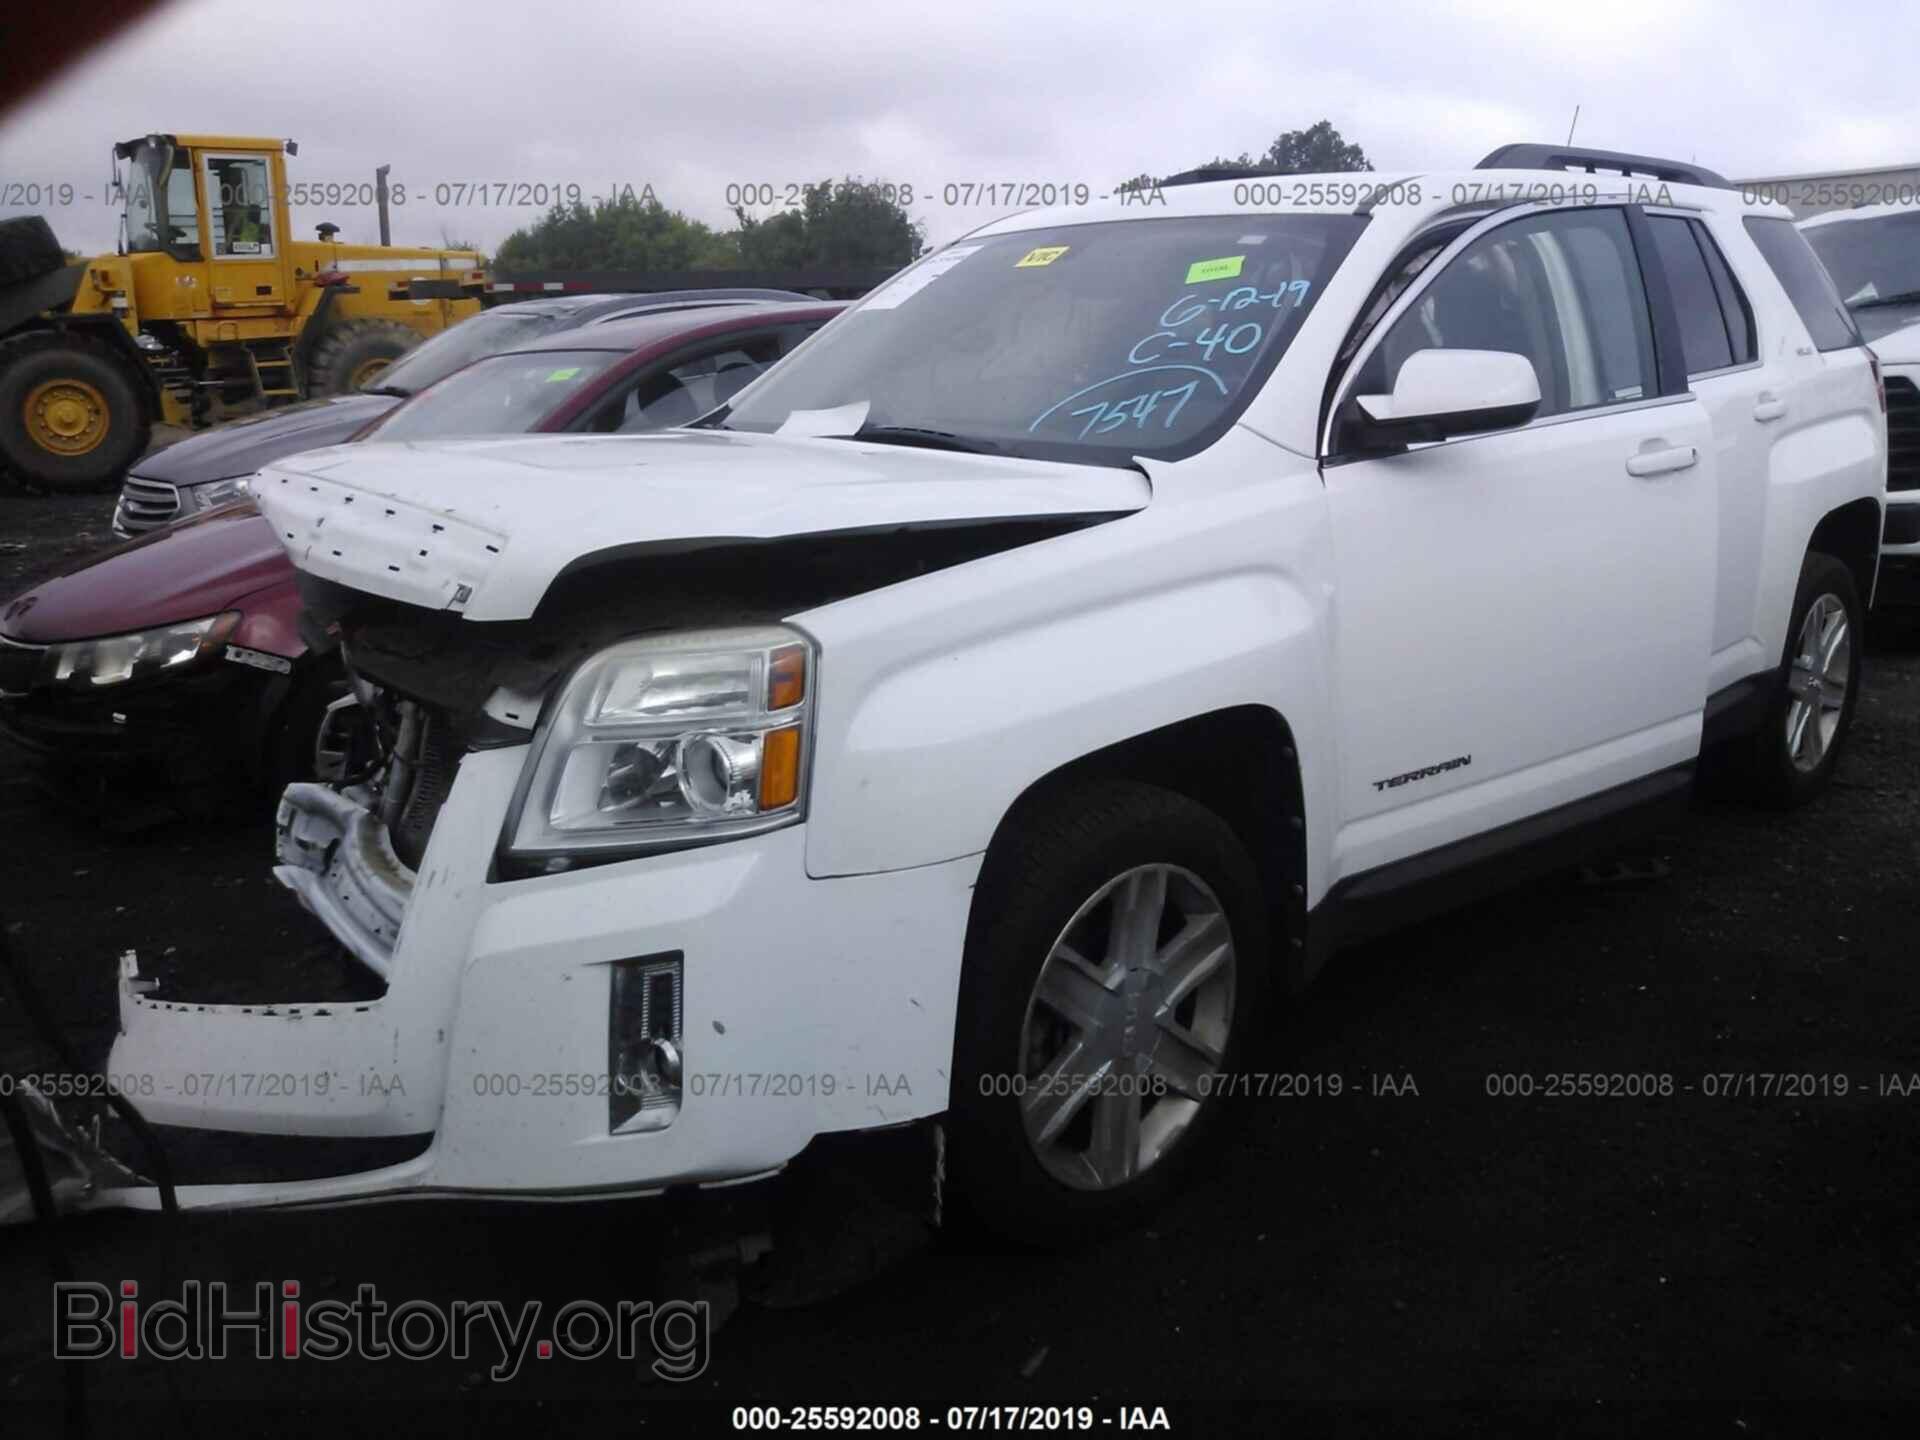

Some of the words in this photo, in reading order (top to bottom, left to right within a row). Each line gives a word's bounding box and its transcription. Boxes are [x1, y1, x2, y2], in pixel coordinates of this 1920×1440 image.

[1128, 322, 1262, 364] C-40
[1071, 379, 1199, 440] 7547
[1371, 754, 1471, 792] TERRAIN
